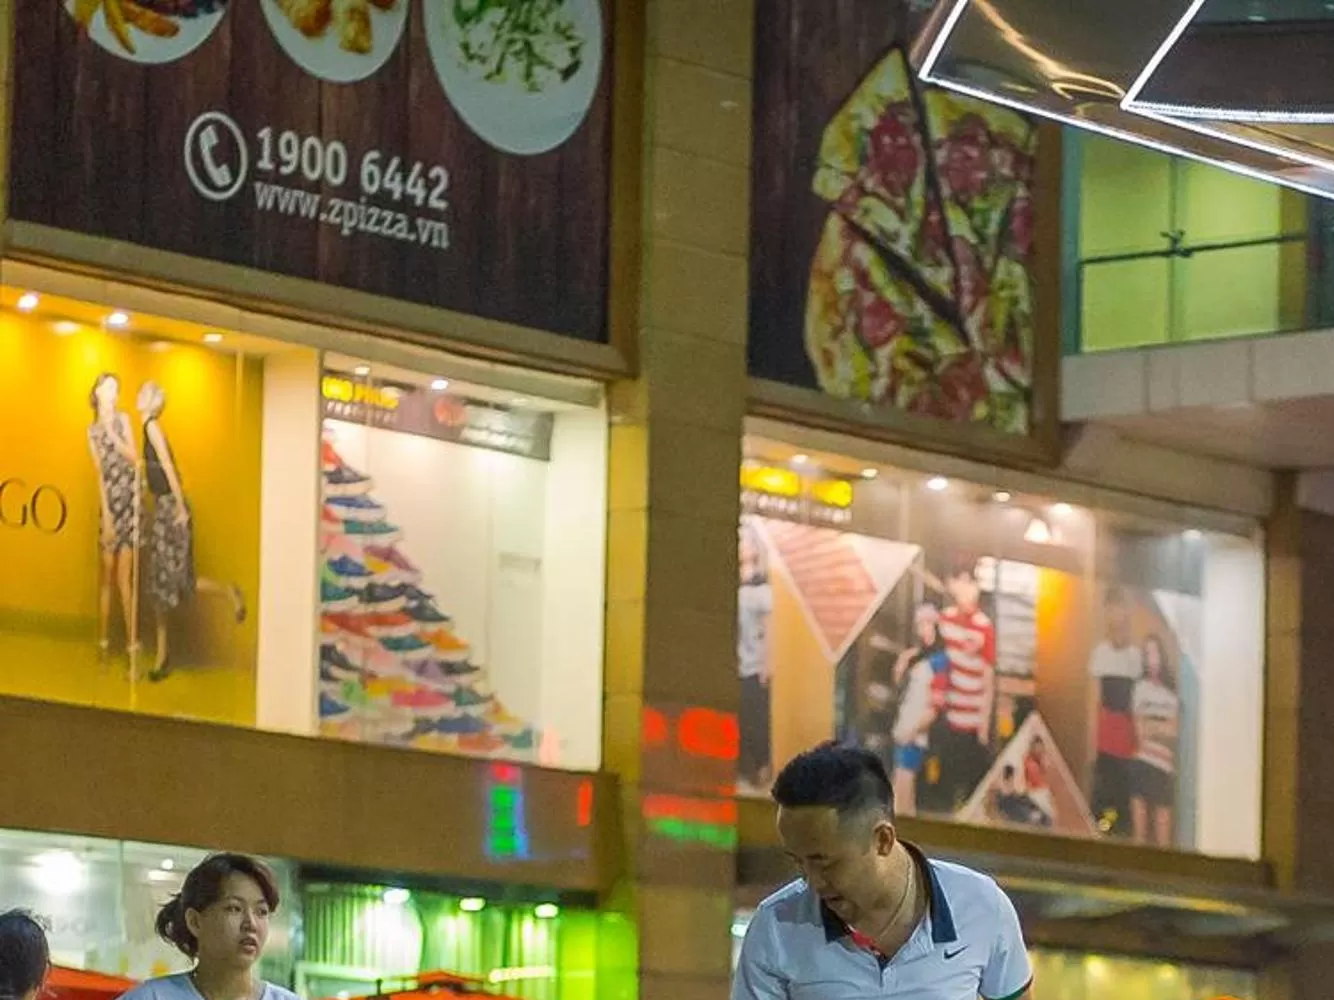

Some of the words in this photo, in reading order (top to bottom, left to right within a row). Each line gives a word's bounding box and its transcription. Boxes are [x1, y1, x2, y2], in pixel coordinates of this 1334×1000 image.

[256, 125, 348, 187] 1900
[360, 150, 450, 211] 6442
[253, 180, 451, 250] www.zpizza.vn
